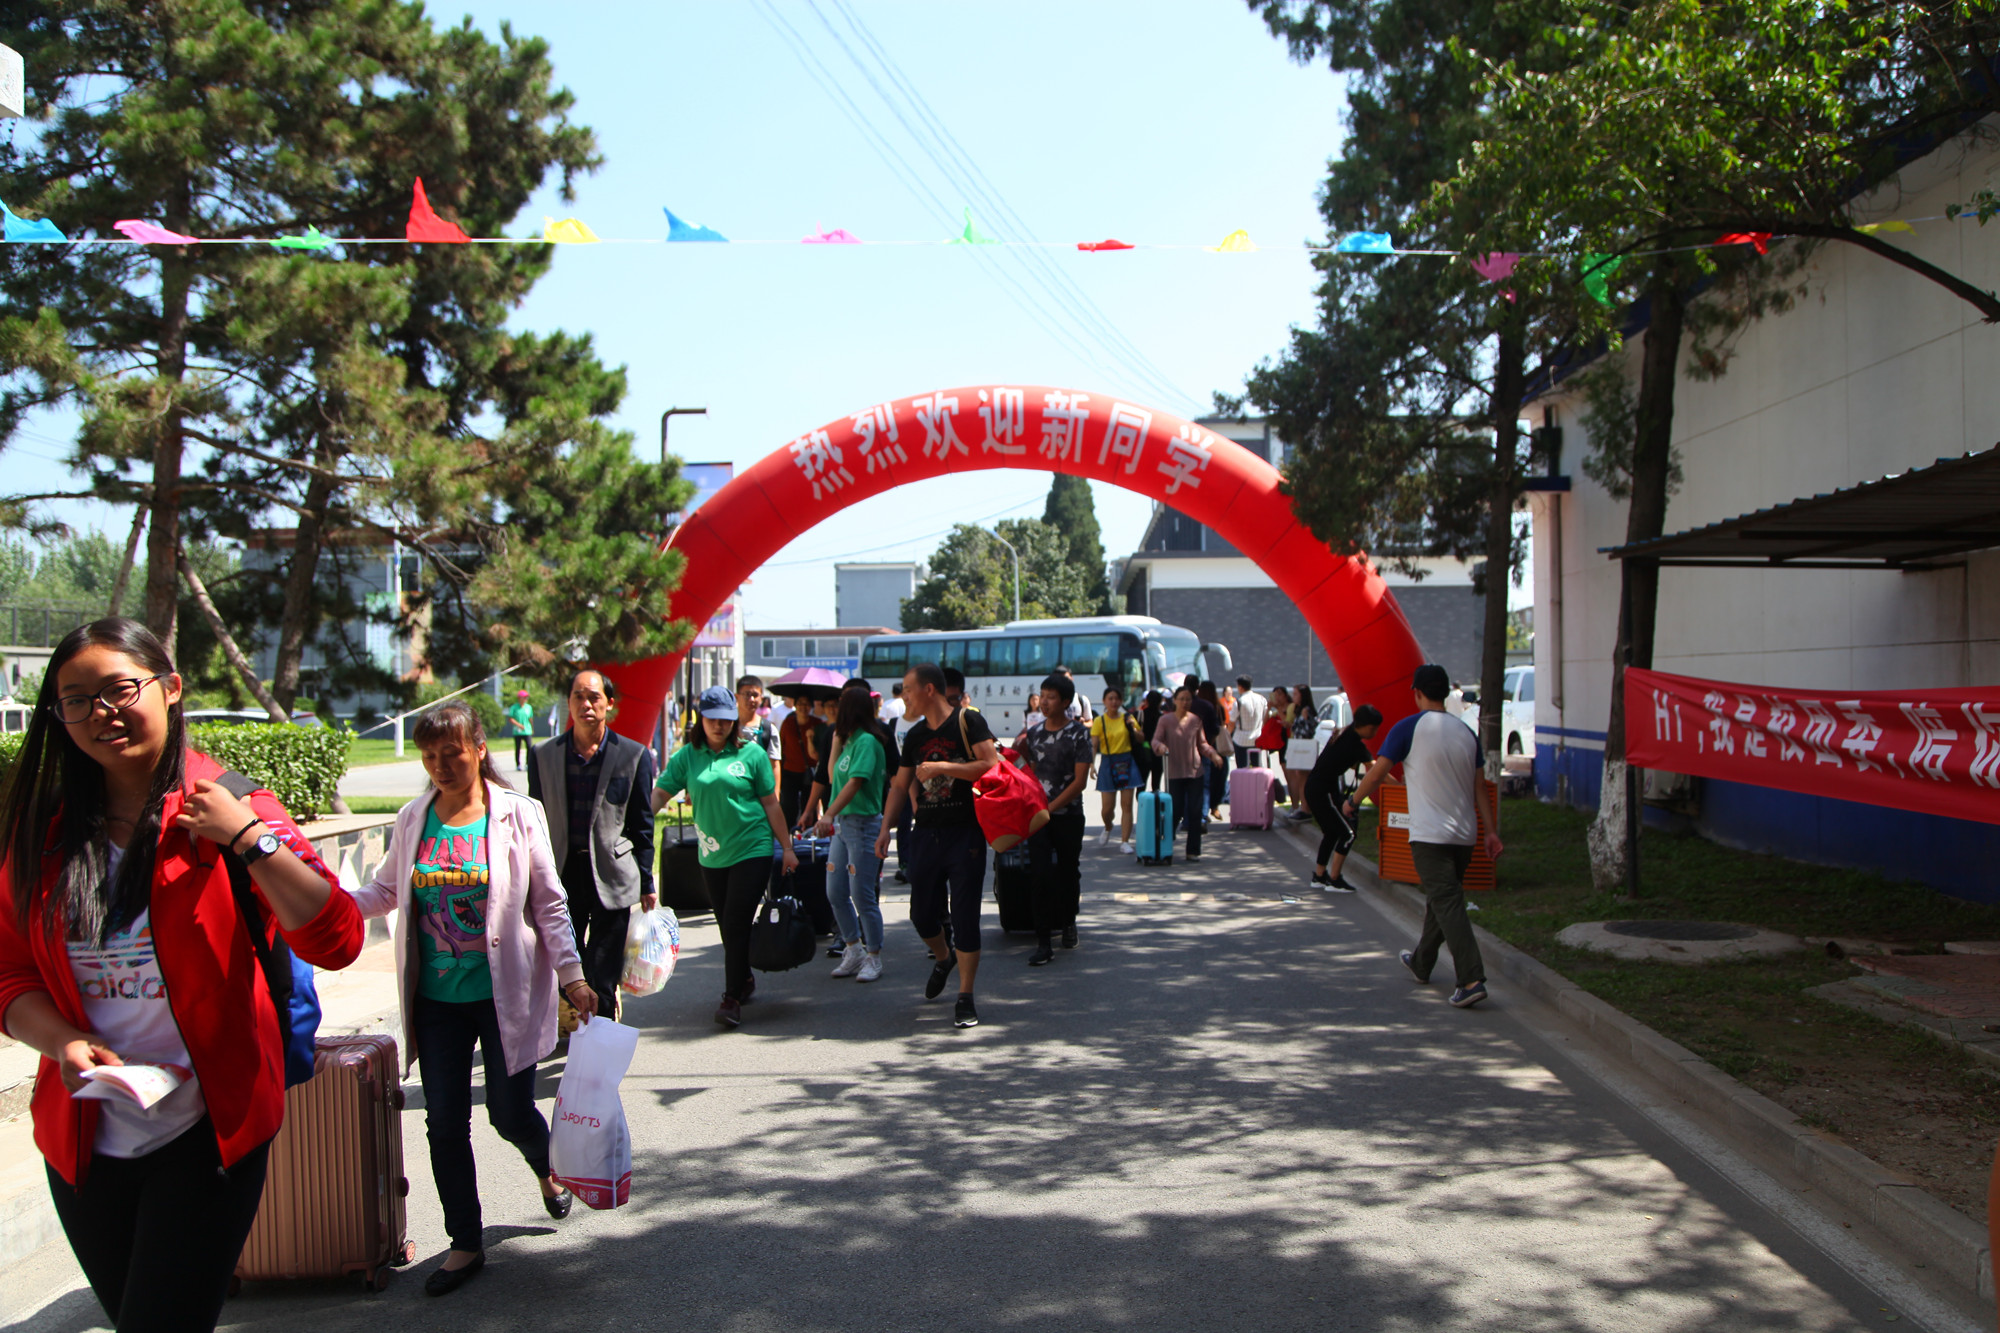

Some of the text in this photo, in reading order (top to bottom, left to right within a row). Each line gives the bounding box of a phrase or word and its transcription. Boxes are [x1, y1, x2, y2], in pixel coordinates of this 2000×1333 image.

[790, 387, 1214, 500] 热烈欢迎新同学
[413, 866, 489, 888] ombi
